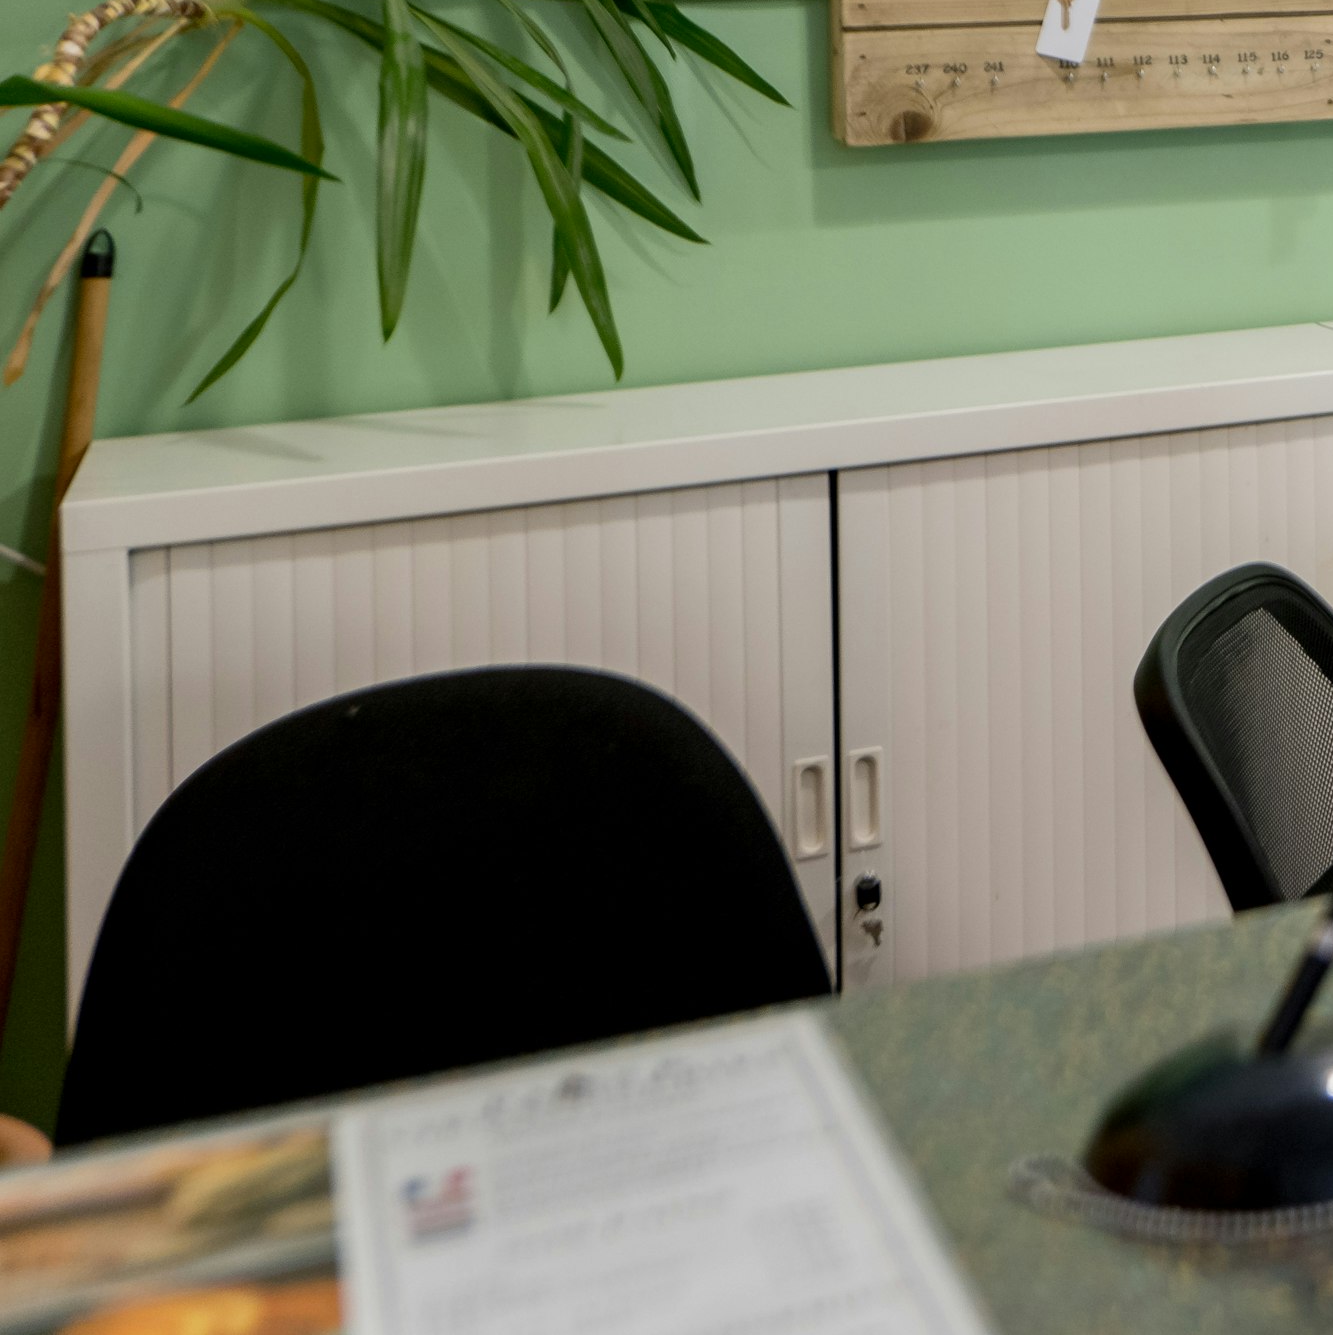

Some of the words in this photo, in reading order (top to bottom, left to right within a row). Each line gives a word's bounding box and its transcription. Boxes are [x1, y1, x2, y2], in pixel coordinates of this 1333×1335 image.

[1096, 56, 1114, 67] 111
[1133, 55, 1152, 65] 112
[1168, 54, 1188, 64] 113
[1202, 54, 1220, 64] 114
[1237, 52, 1257, 63] 115
[1271, 51, 1289, 61] 116
[1304, 49, 1324, 60] 125
